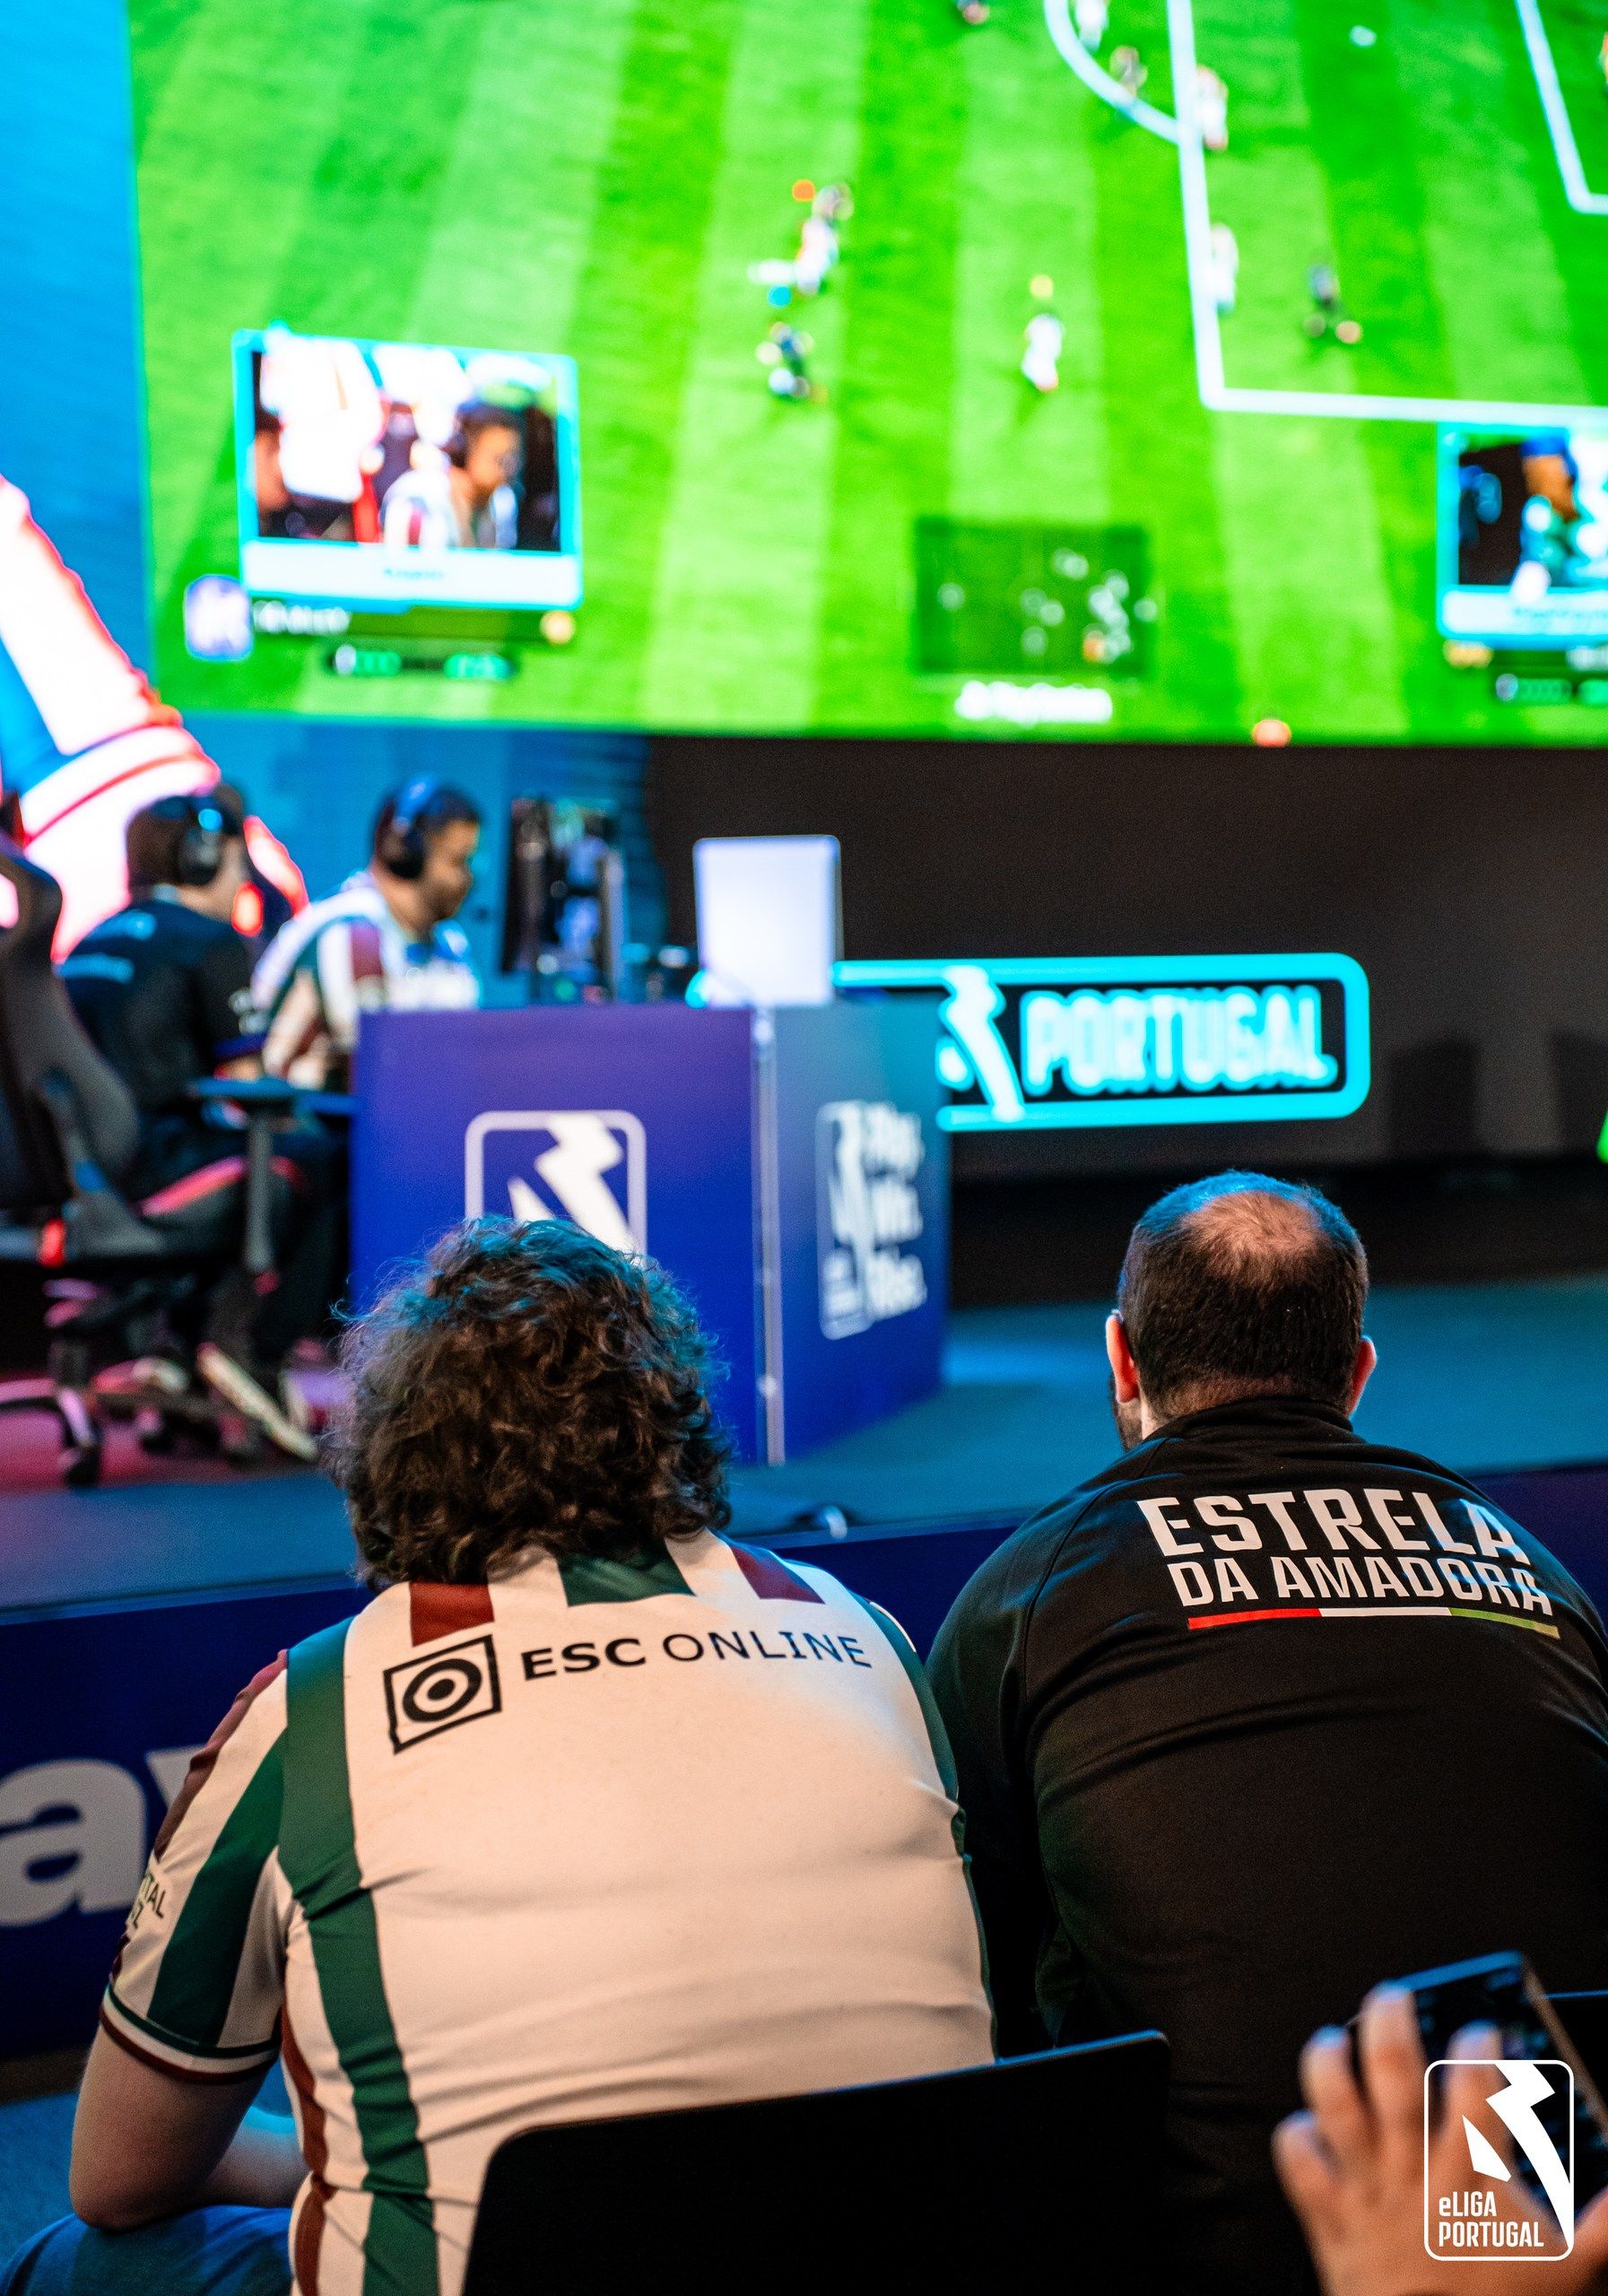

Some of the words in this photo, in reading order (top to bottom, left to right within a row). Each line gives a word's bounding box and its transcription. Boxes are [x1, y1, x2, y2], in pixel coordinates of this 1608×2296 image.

[1021, 986, 1338, 1096] PORTUGAL
[1136, 1488, 1530, 1565] ESTRELA
[1168, 1560, 1259, 1607] DA
[1273, 1557, 1553, 1616] AMADORA
[521, 1638, 646, 1682] ESC
[663, 1631, 873, 1668] ONLINE
